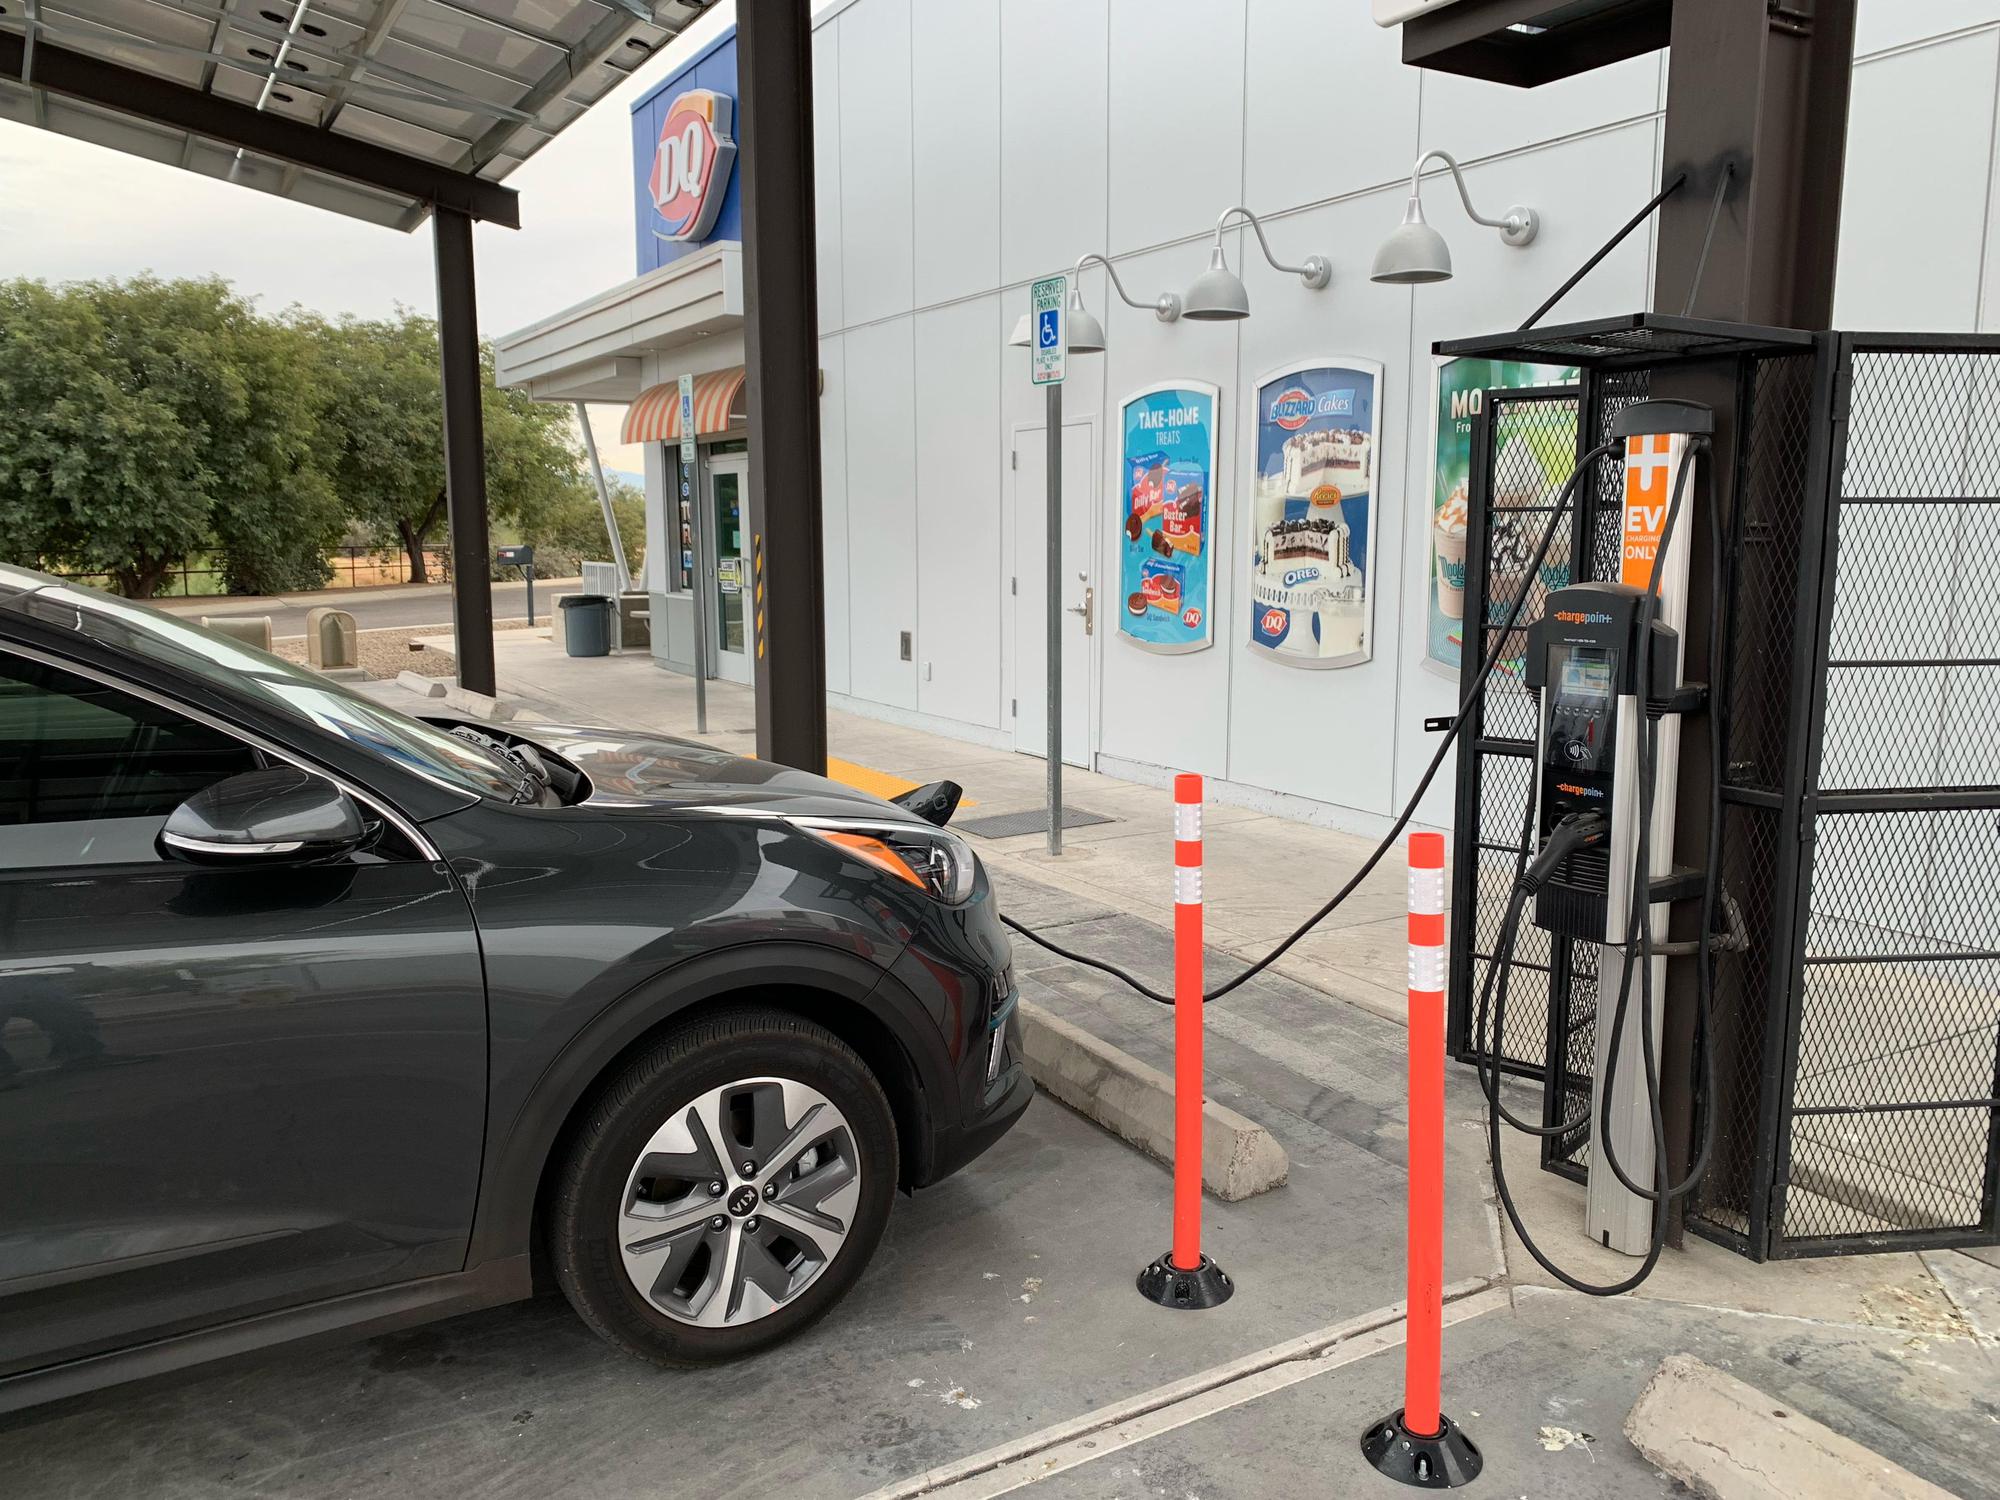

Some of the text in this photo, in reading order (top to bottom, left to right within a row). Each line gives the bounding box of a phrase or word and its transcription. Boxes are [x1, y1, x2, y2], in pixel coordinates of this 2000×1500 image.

[658, 121, 704, 207] DQ
[1034, 280, 1064, 299] RESERVED
[1036, 294, 1061, 312] PARKING
[1270, 398, 1317, 422] BLIZZARD
[1318, 394, 1349, 413] Cakes
[1139, 406, 1200, 430] TAKE-HOME
[1156, 430, 1181, 446] TREATS
[1135, 488, 1161, 510] Dilly Bar
[1163, 507, 1188, 521] Buster
[1627, 505, 1665, 532] EV
[1169, 520, 1183, 533] Bar
[1284, 567, 1320, 585] OREO
[1186, 612, 1200, 625] DQ
[1266, 616, 1283, 630] DQ
[731, 1189, 756, 1213] KIA
